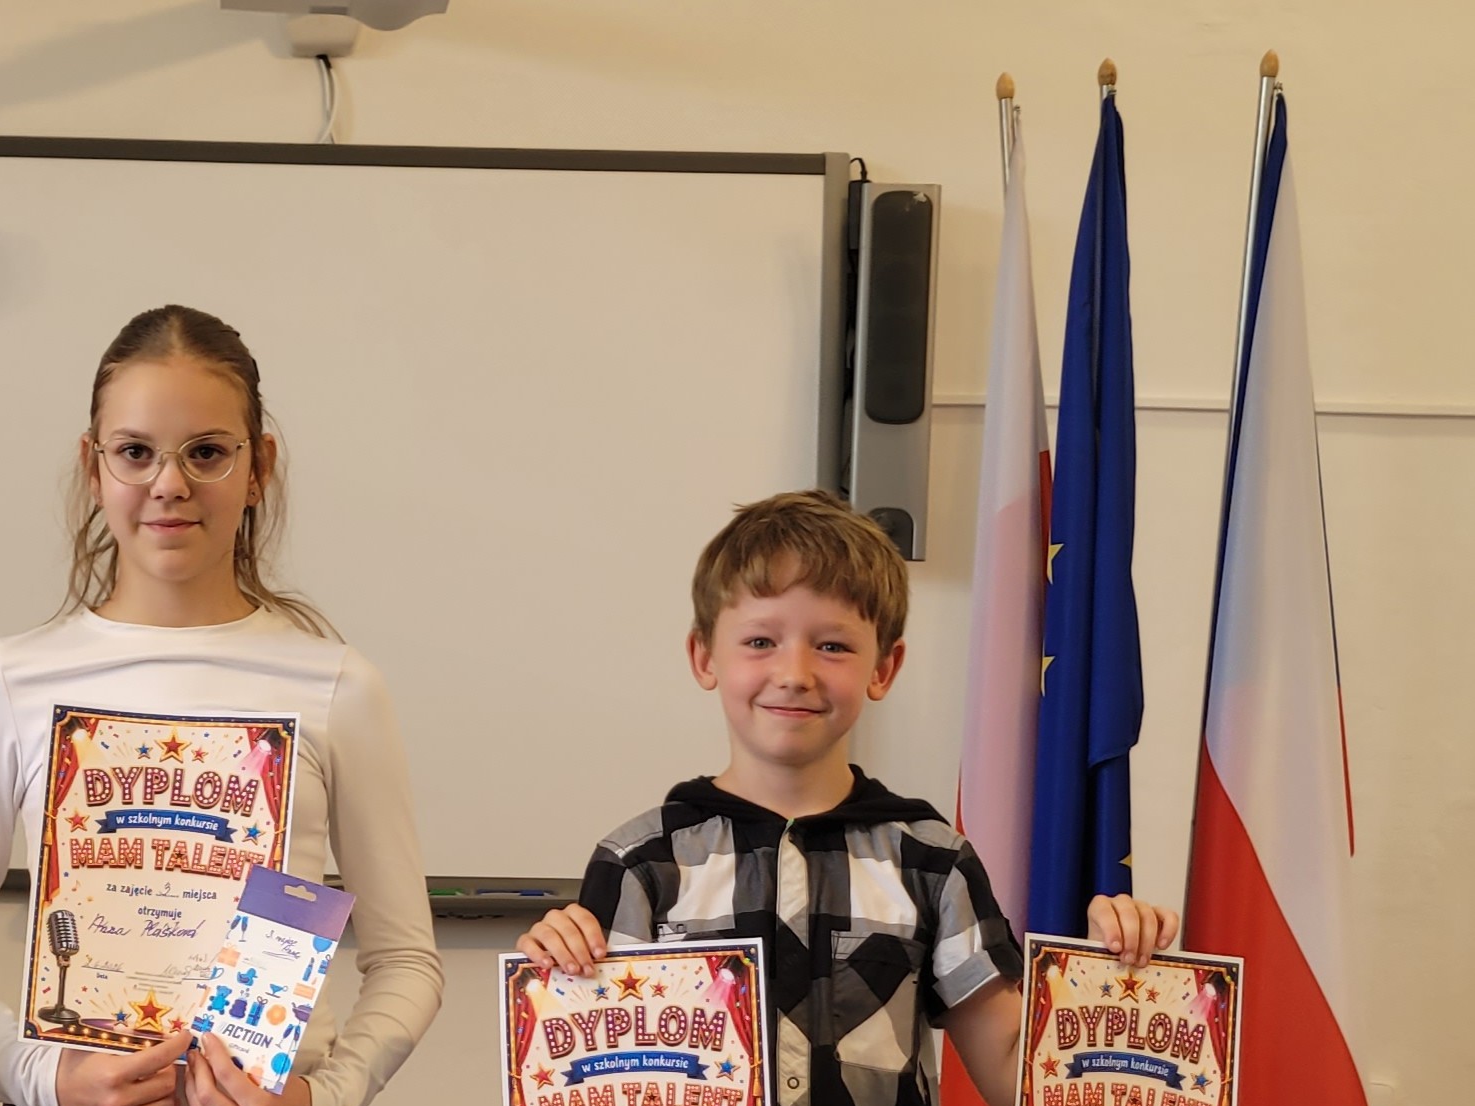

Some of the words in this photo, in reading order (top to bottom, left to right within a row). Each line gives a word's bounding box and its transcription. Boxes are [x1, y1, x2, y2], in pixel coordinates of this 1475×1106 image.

[83, 765, 260, 817] DYPLOM
[116, 815, 124, 825] w
[128, 810, 172, 826] szkolnym
[174, 814, 220, 831] konkursie
[70, 837, 144, 870] MAM
[151, 838, 265, 881] TALENT
[106, 884, 118, 893] za
[120, 884, 153, 898] zajęcie
[183, 887, 218, 903] miejsca
[138, 906, 183, 921] otrzymuje
[222, 1023, 274, 1049] ACTION
[542, 1005, 728, 1059] DYPLOM
[1055, 1005, 1206, 1064] DYPLOM
[581, 1063, 591, 1074] w
[594, 1058, 640, 1075] szkolnym
[642, 1055, 689, 1070] konkursie
[1081, 1058, 1089, 1068] w
[1092, 1055, 1128, 1071] szkolnym
[1130, 1058, 1169, 1078] konkursie
